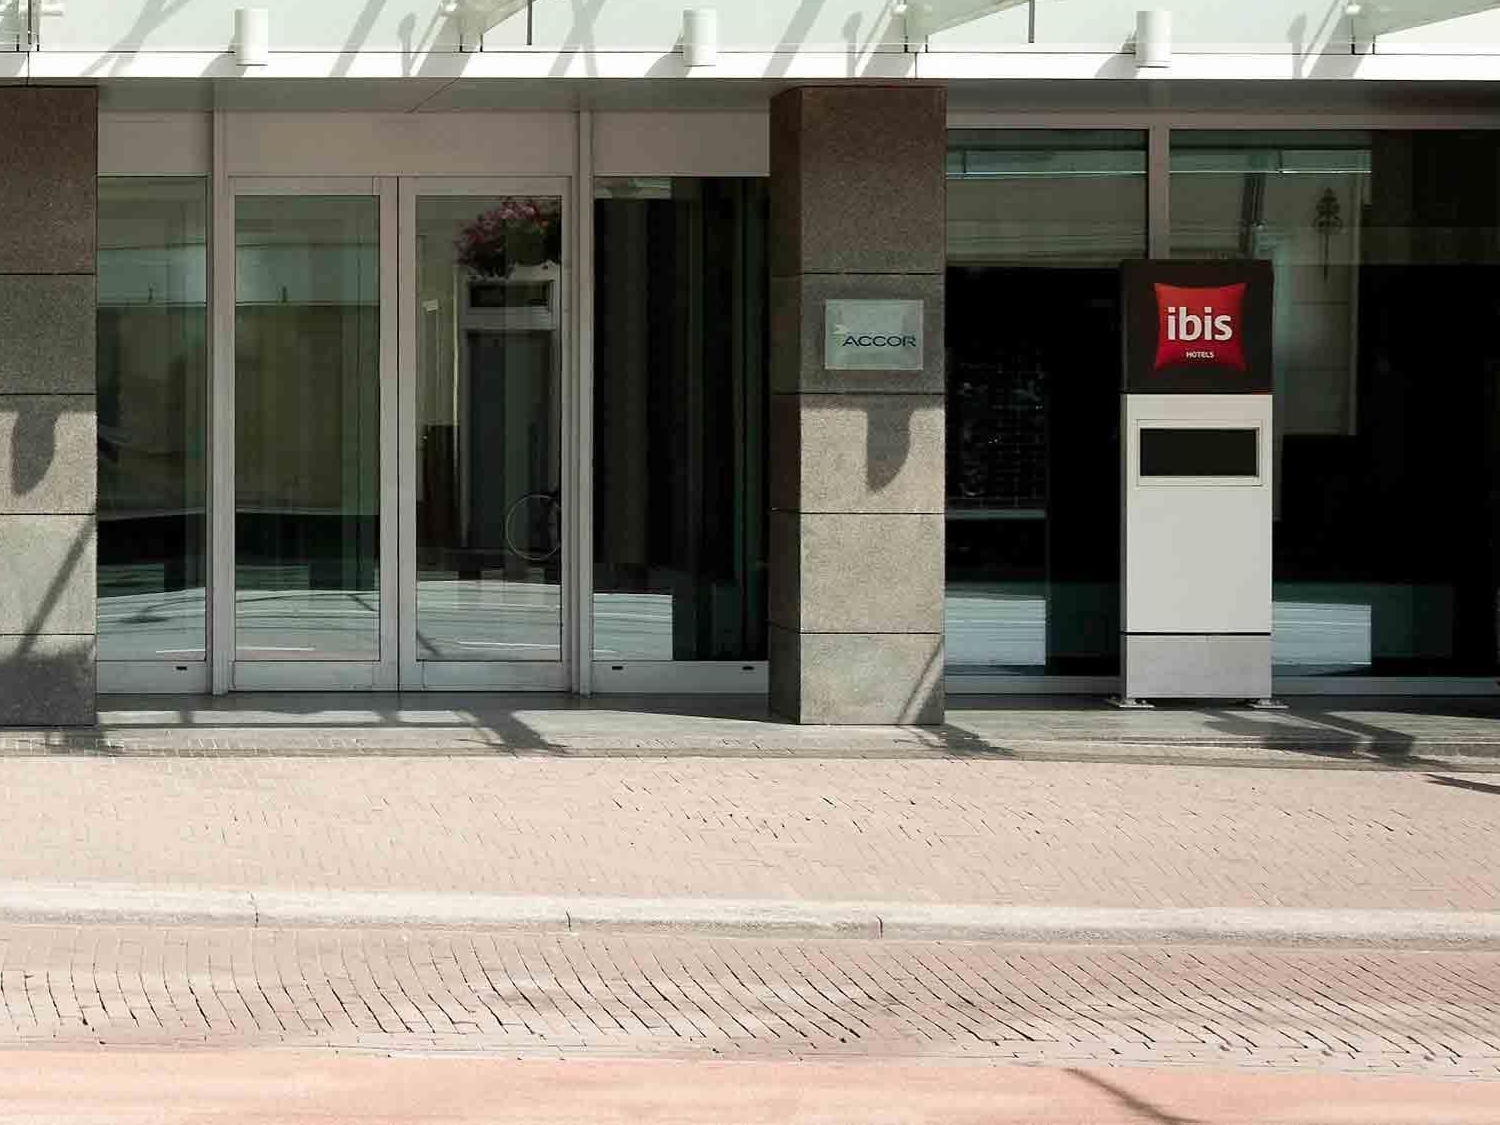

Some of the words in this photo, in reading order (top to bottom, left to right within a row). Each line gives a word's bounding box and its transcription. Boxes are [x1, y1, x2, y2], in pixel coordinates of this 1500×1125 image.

[1167, 306, 1233, 341] ibis
[842, 335, 917, 347] ACCOR
[1186, 351, 1215, 359] HOTELS
